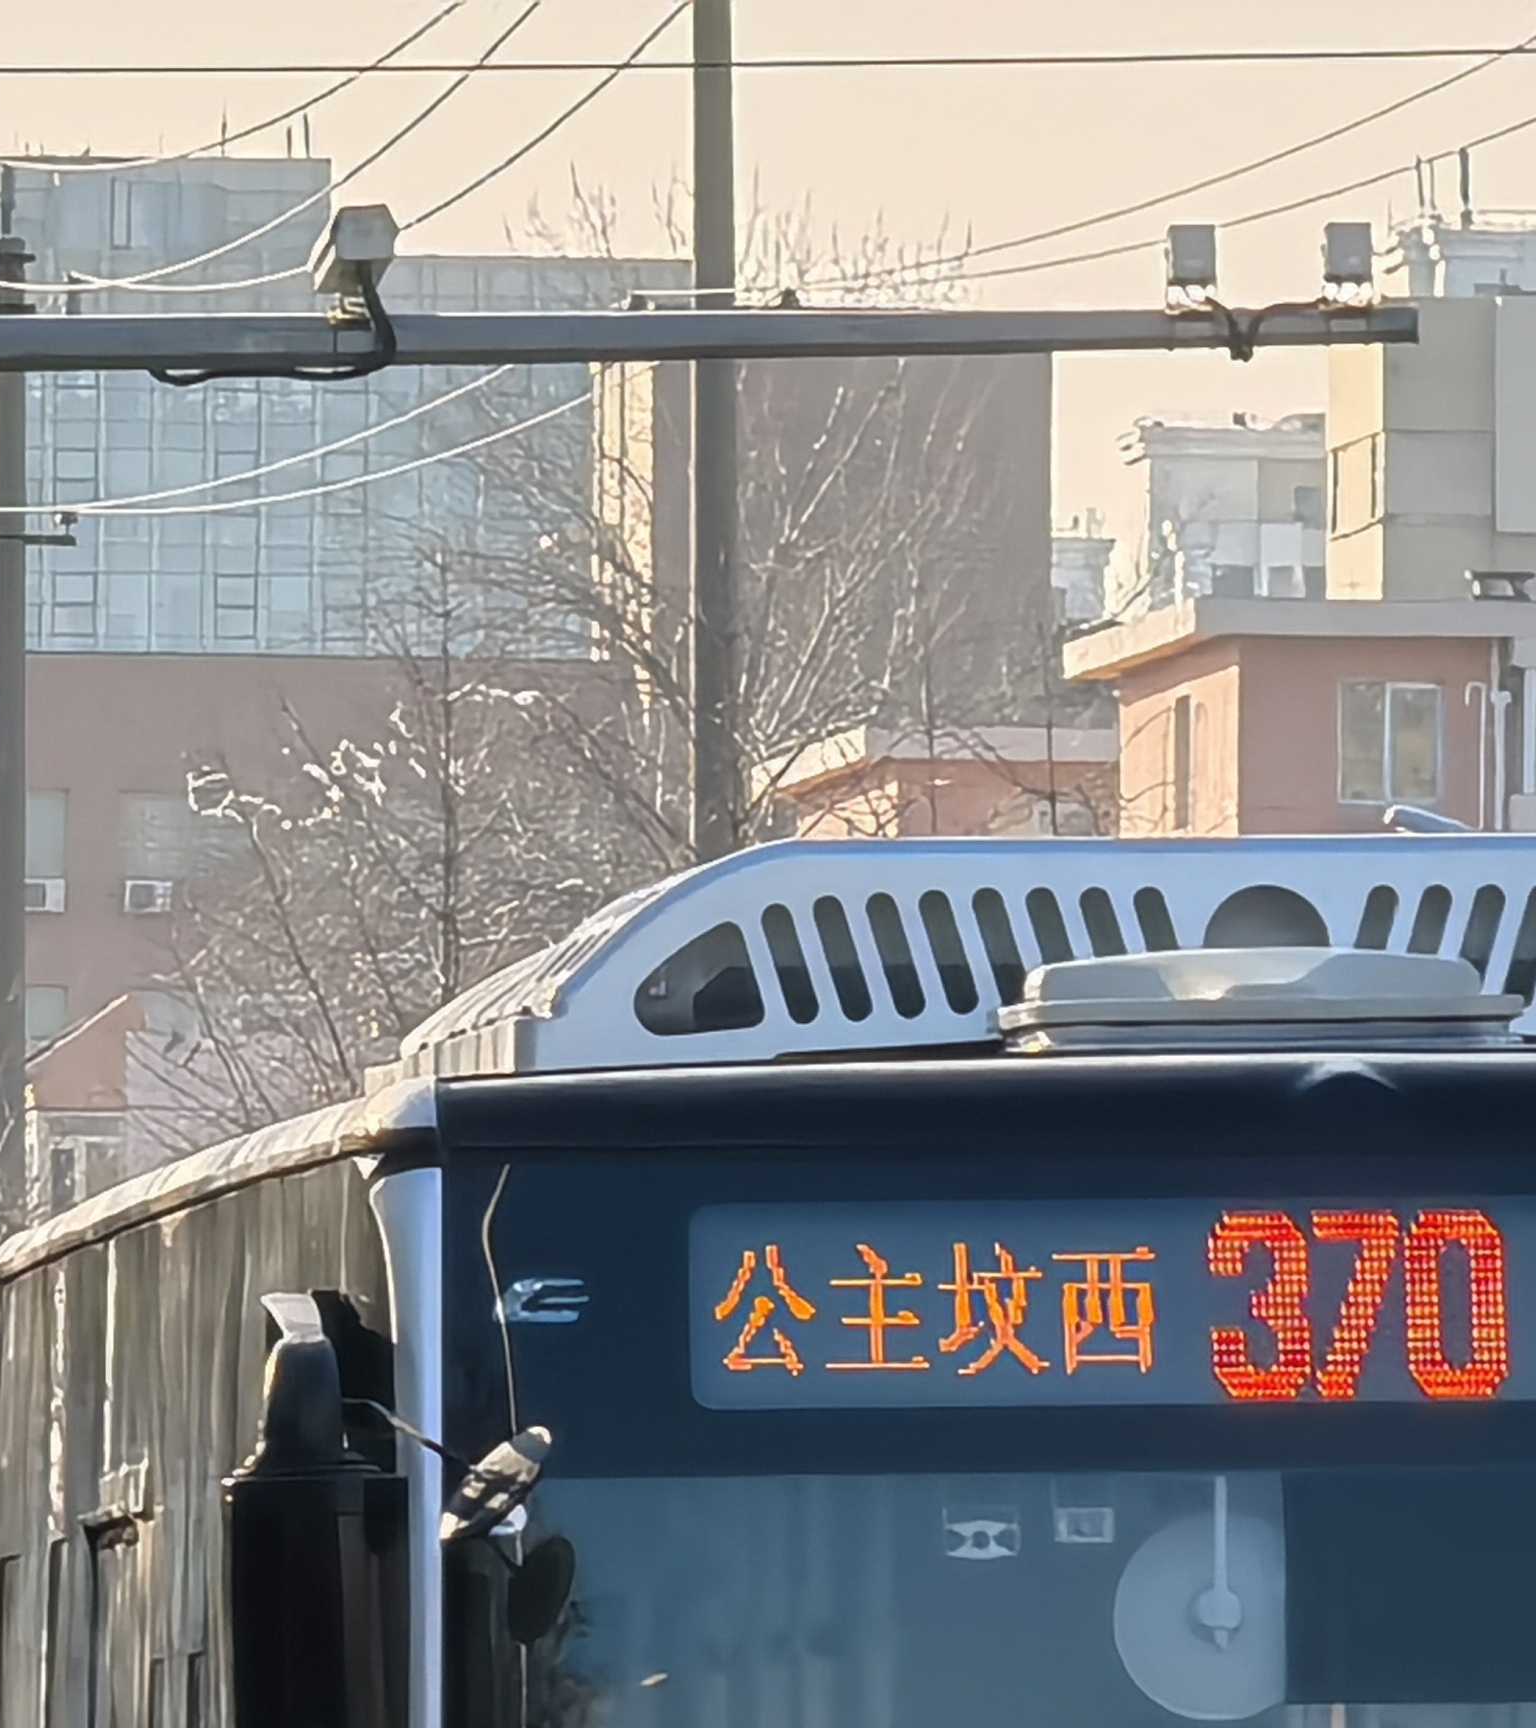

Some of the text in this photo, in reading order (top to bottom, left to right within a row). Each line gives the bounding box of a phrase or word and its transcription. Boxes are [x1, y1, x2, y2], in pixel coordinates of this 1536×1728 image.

[712, 1243, 1157, 1375] 公主坟西
[1205, 1208, 1508, 1399] 370
